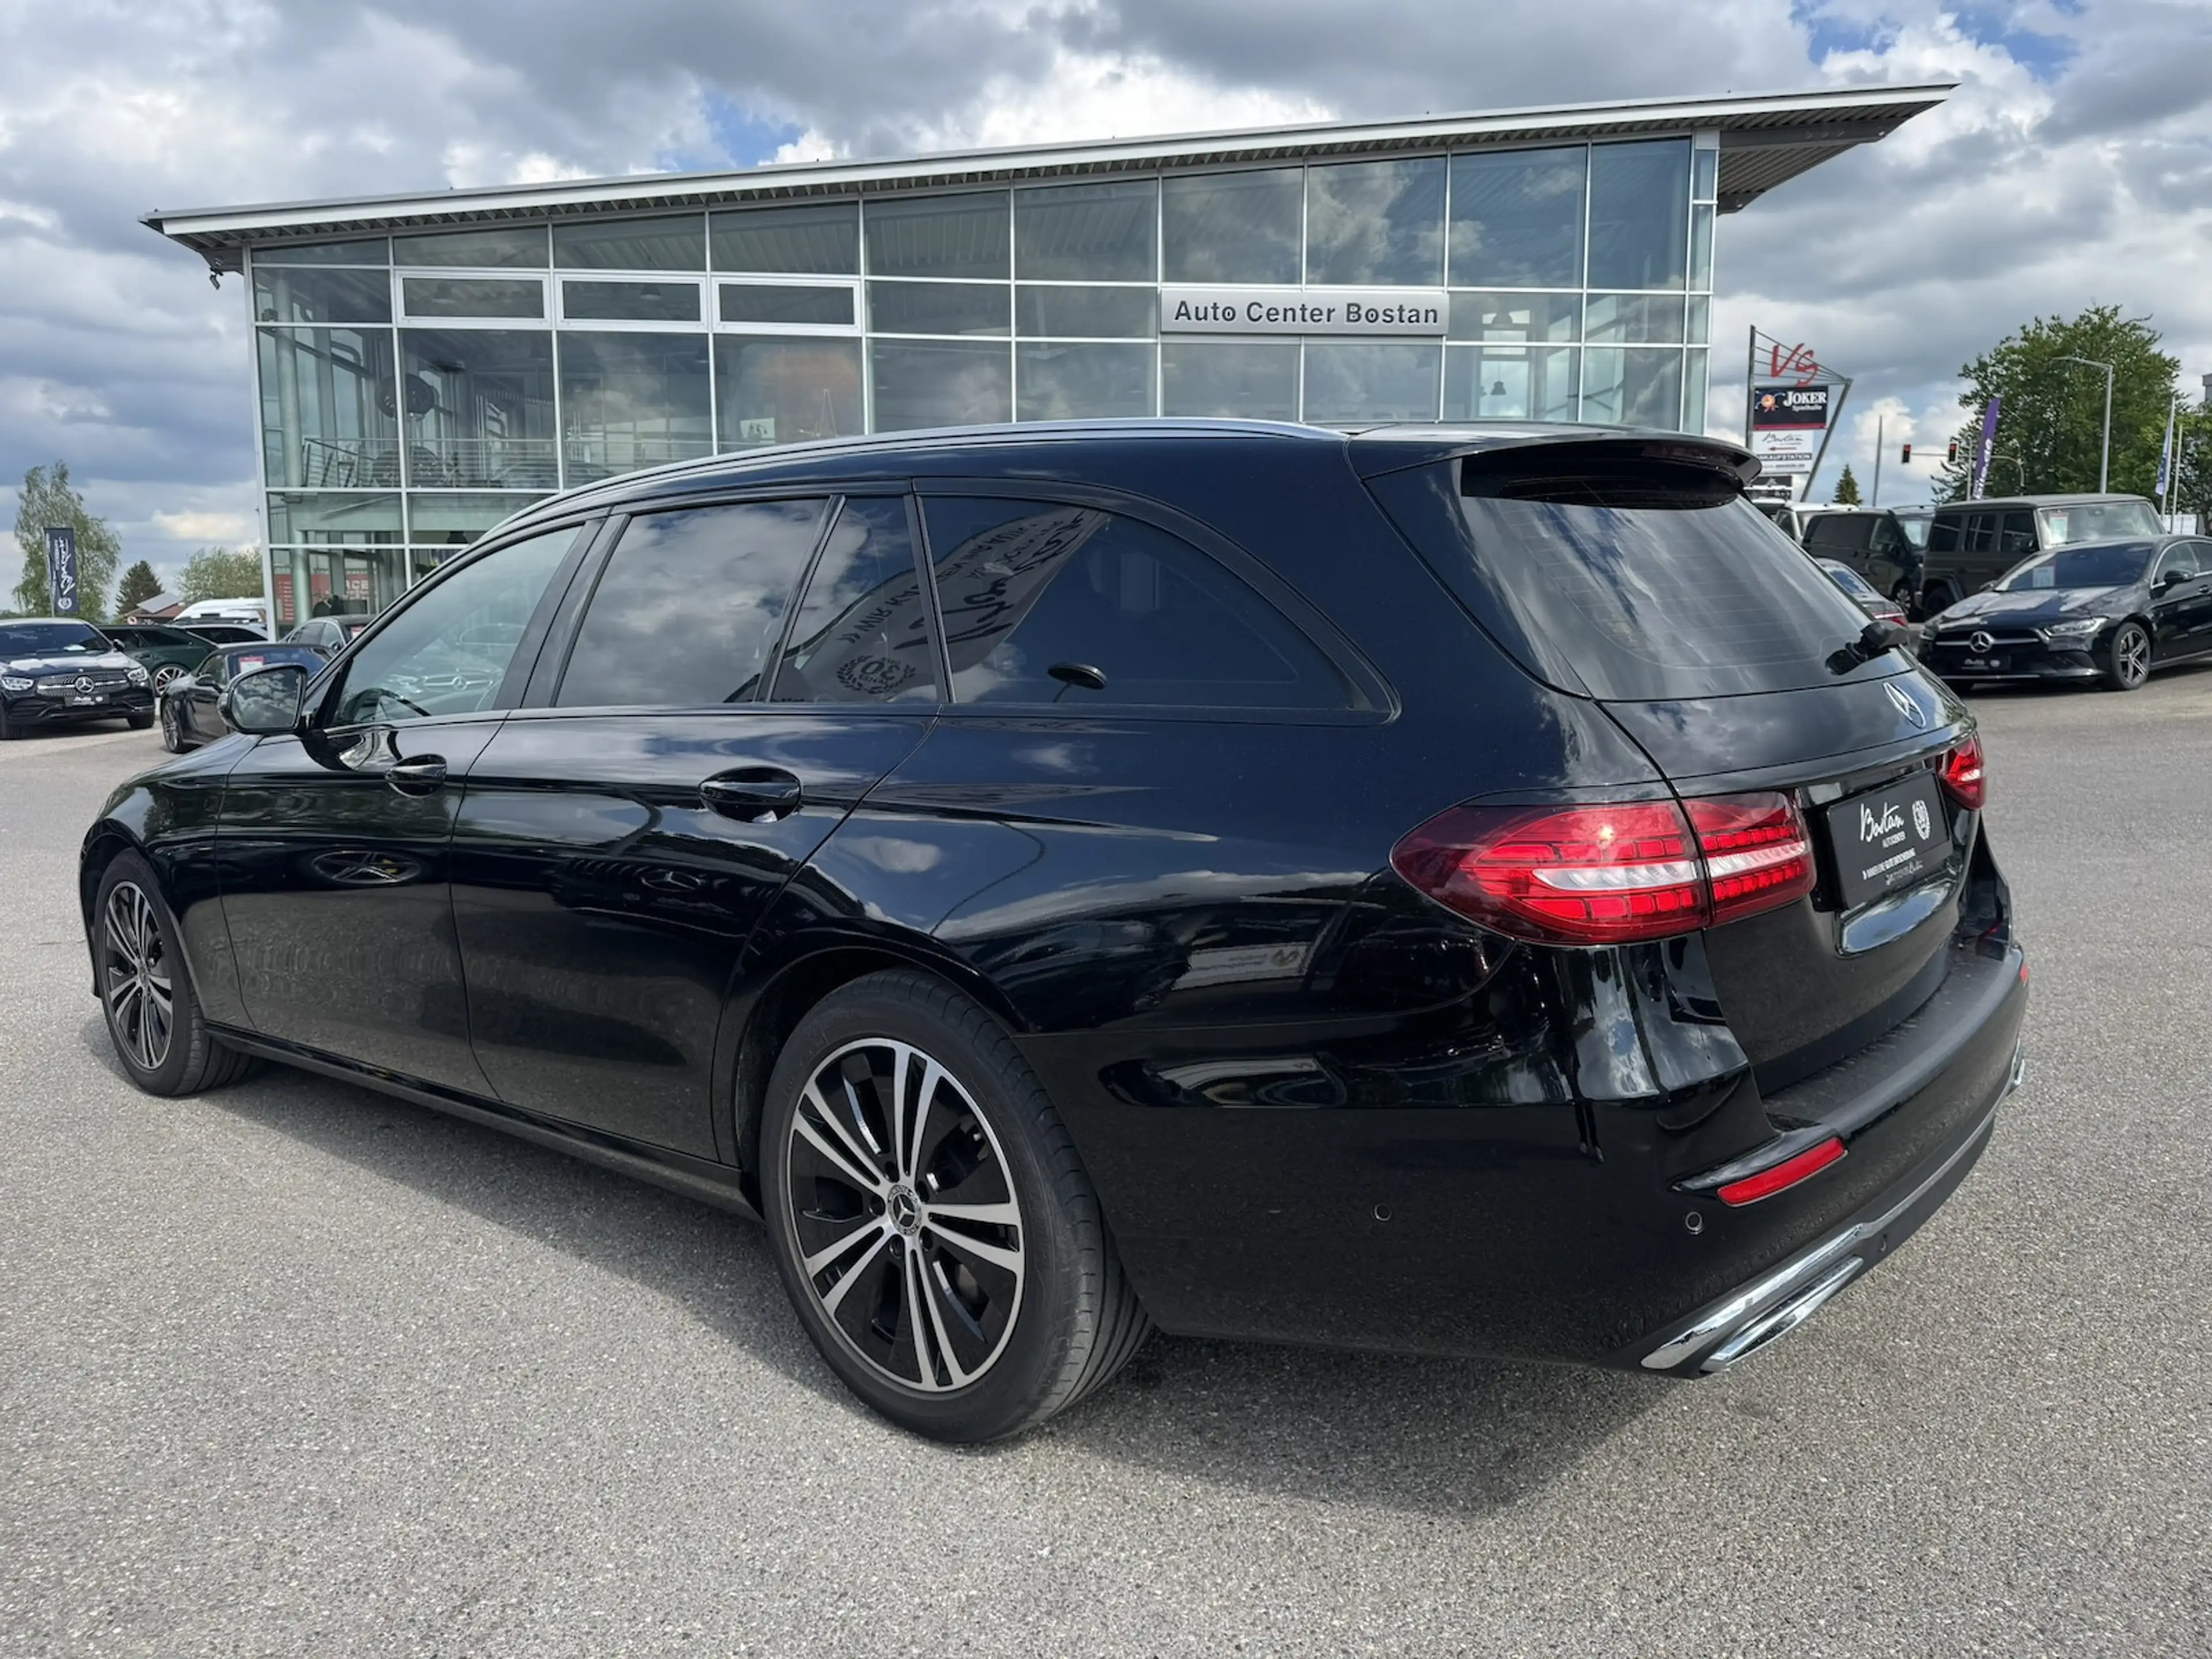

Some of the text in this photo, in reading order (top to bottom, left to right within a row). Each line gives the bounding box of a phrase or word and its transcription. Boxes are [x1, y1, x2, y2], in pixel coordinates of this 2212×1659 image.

[1174, 300, 1438, 324] Auto Center Bostan
[1783, 391, 1827, 407] JOKER
